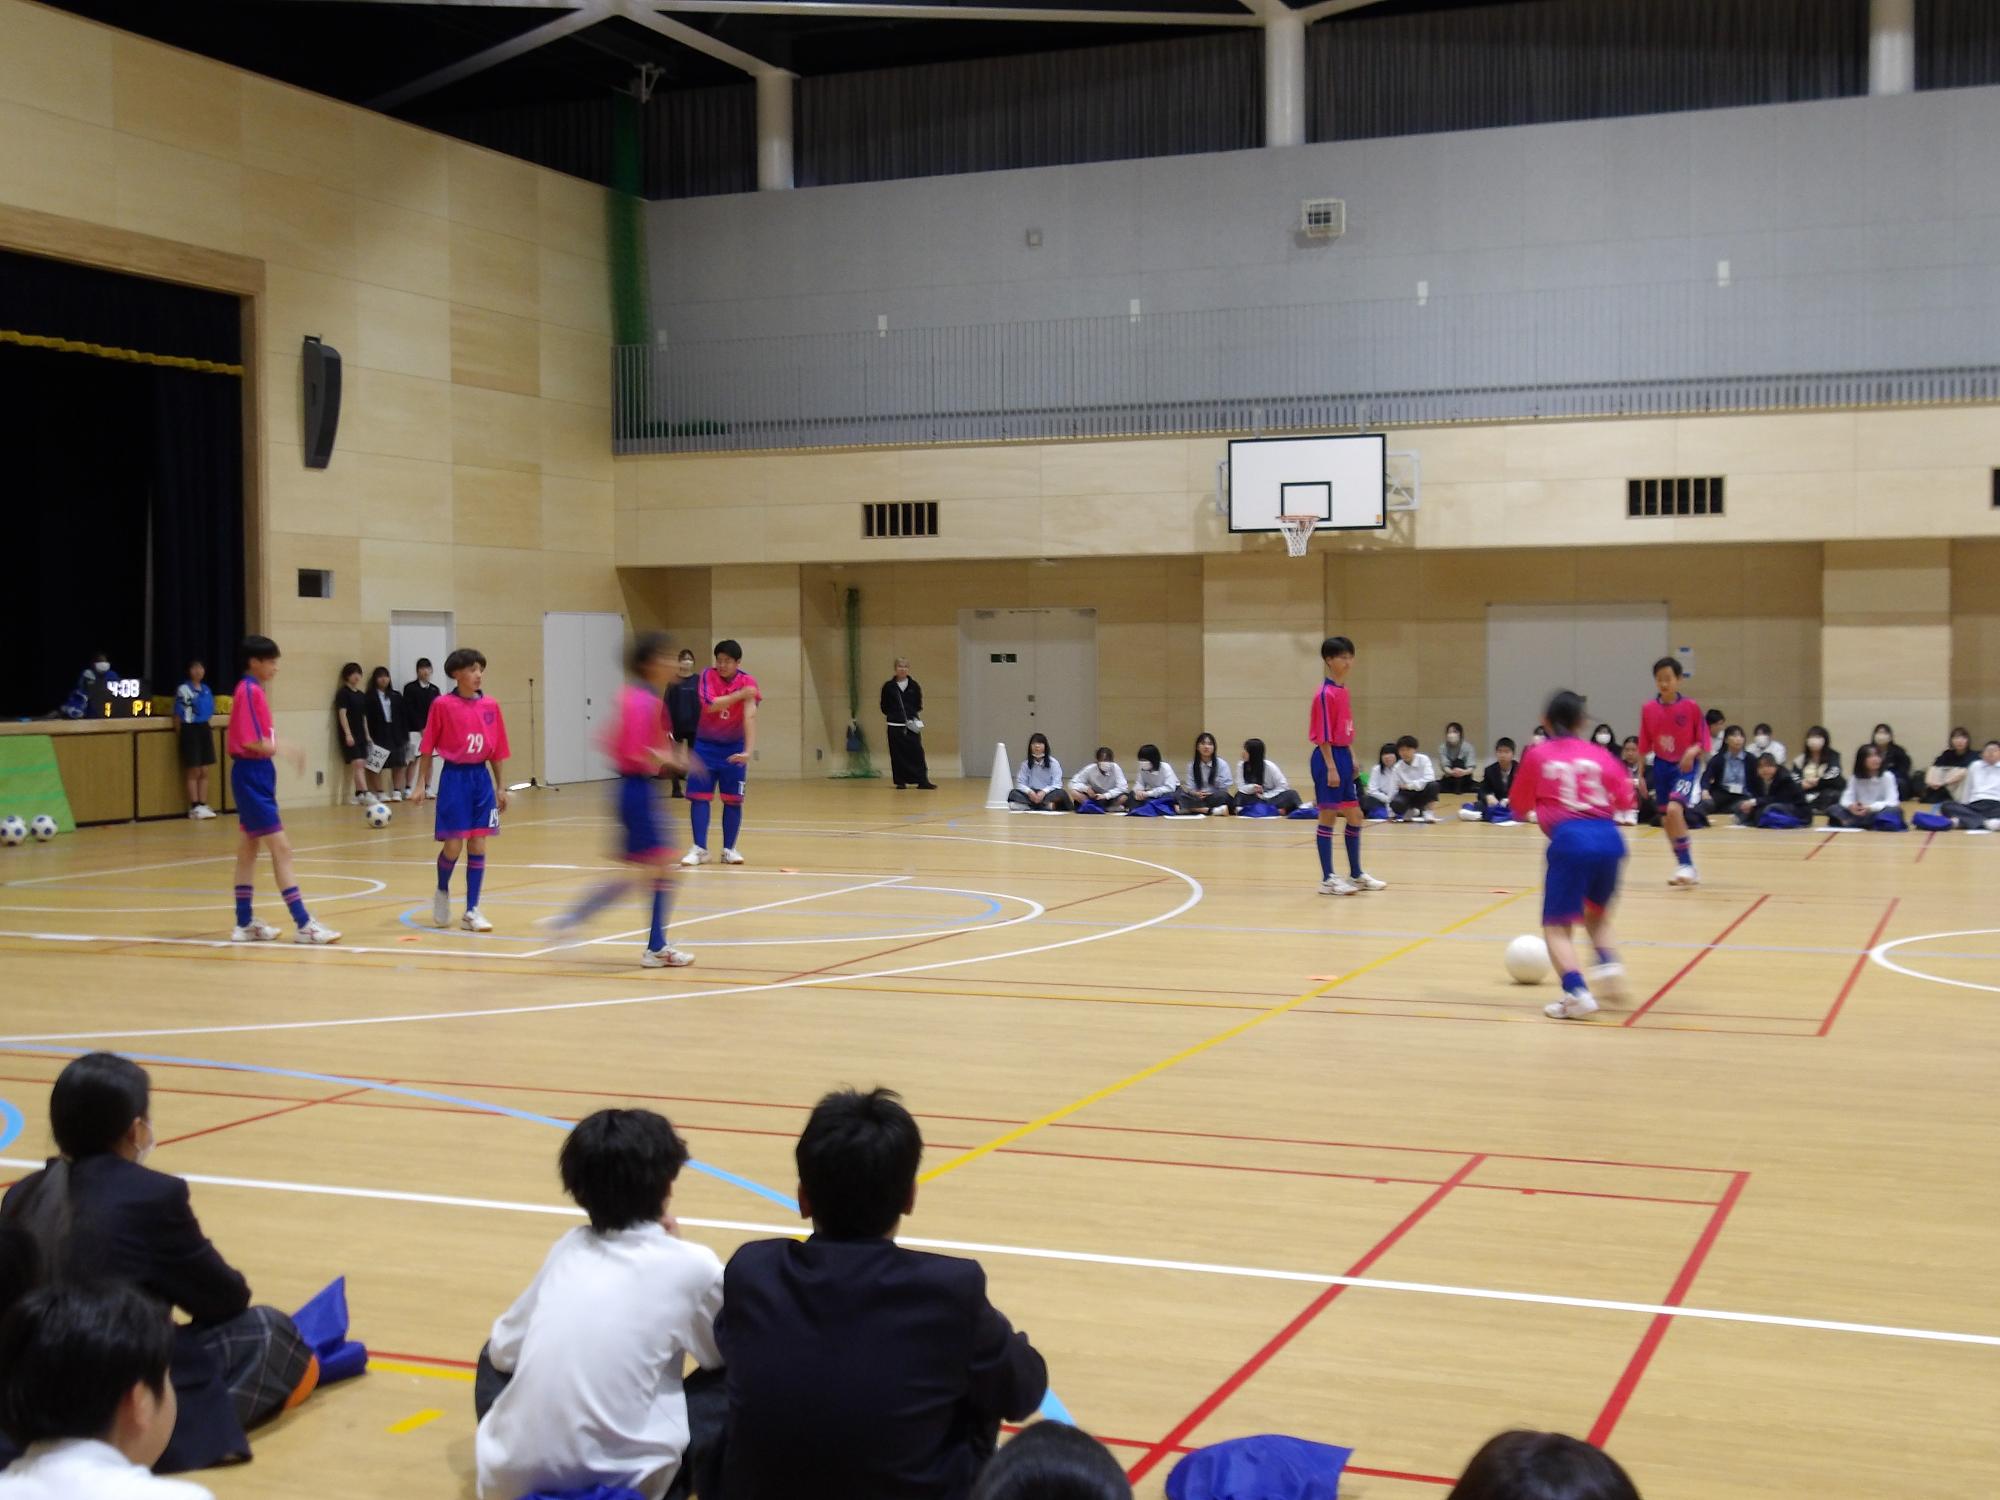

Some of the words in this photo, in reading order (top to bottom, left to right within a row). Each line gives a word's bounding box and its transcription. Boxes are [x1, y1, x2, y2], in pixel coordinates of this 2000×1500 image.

[107, 679, 140, 698] 4:08
[466, 733, 484, 753] 29
[1675, 779, 1692, 797] 98
